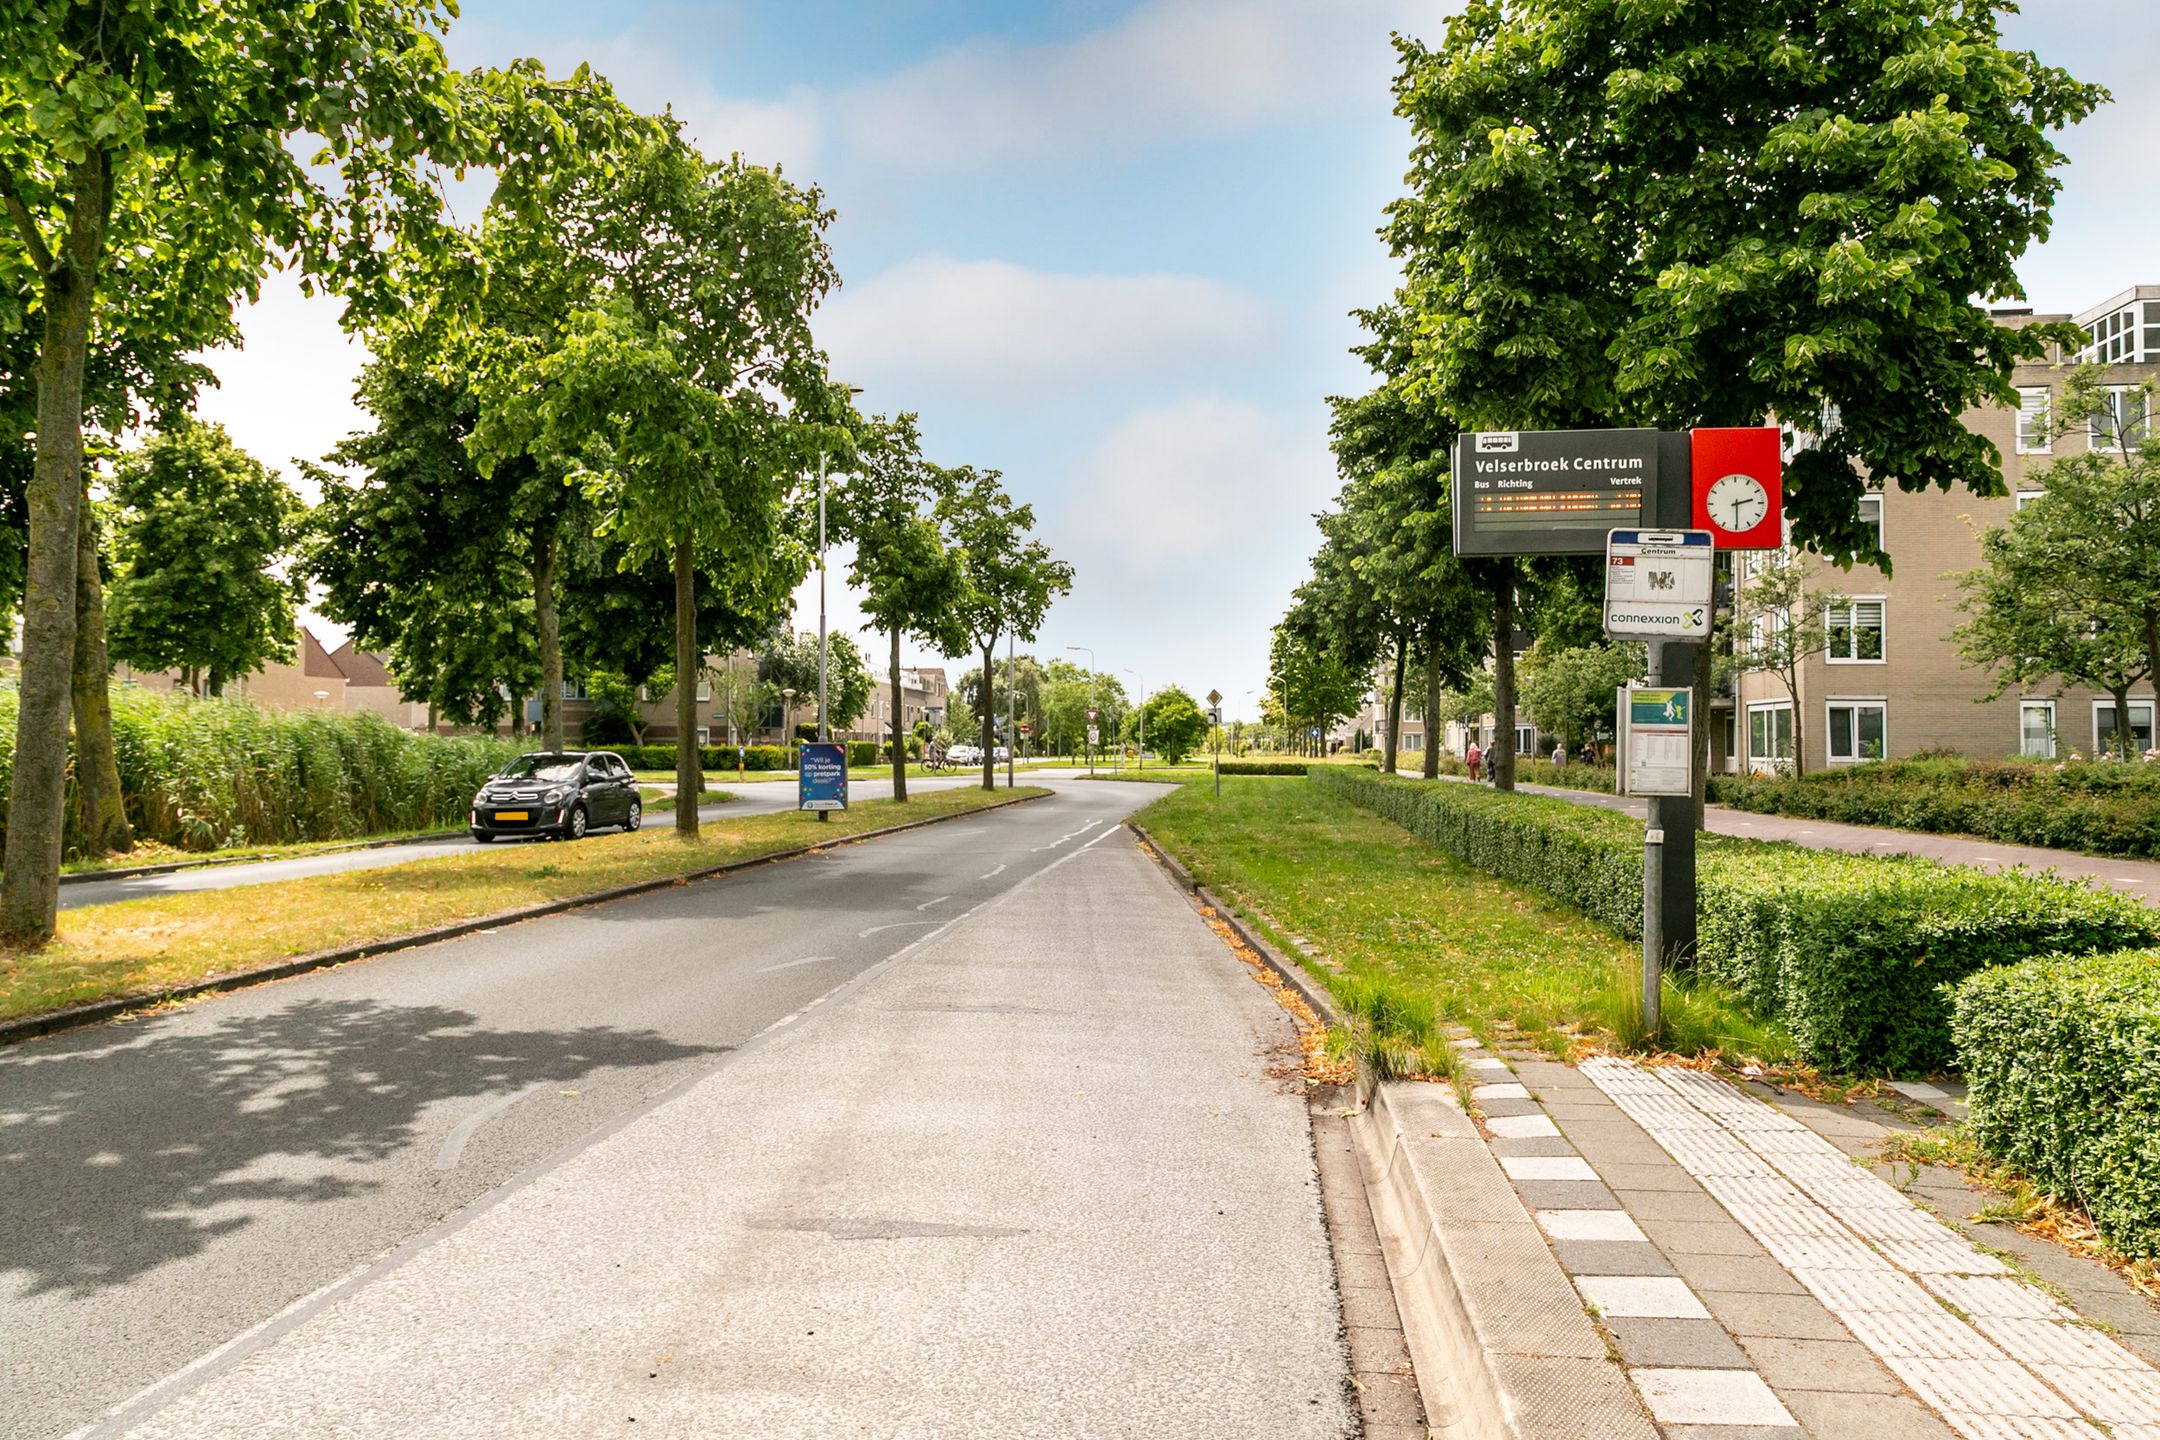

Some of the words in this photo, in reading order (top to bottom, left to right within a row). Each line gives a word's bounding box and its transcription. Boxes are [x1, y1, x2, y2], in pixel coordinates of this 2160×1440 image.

[1475, 457, 1568, 473] Velserbroek
[1573, 457, 1643, 470] Centrum
[1474, 480, 1490, 488] Bus
[1497, 479, 1533, 489] Richting
[1610, 476, 1642, 485] Vertrek
[1641, 547, 1676, 555] Centrum
[1611, 614, 1680, 624] connexxion
